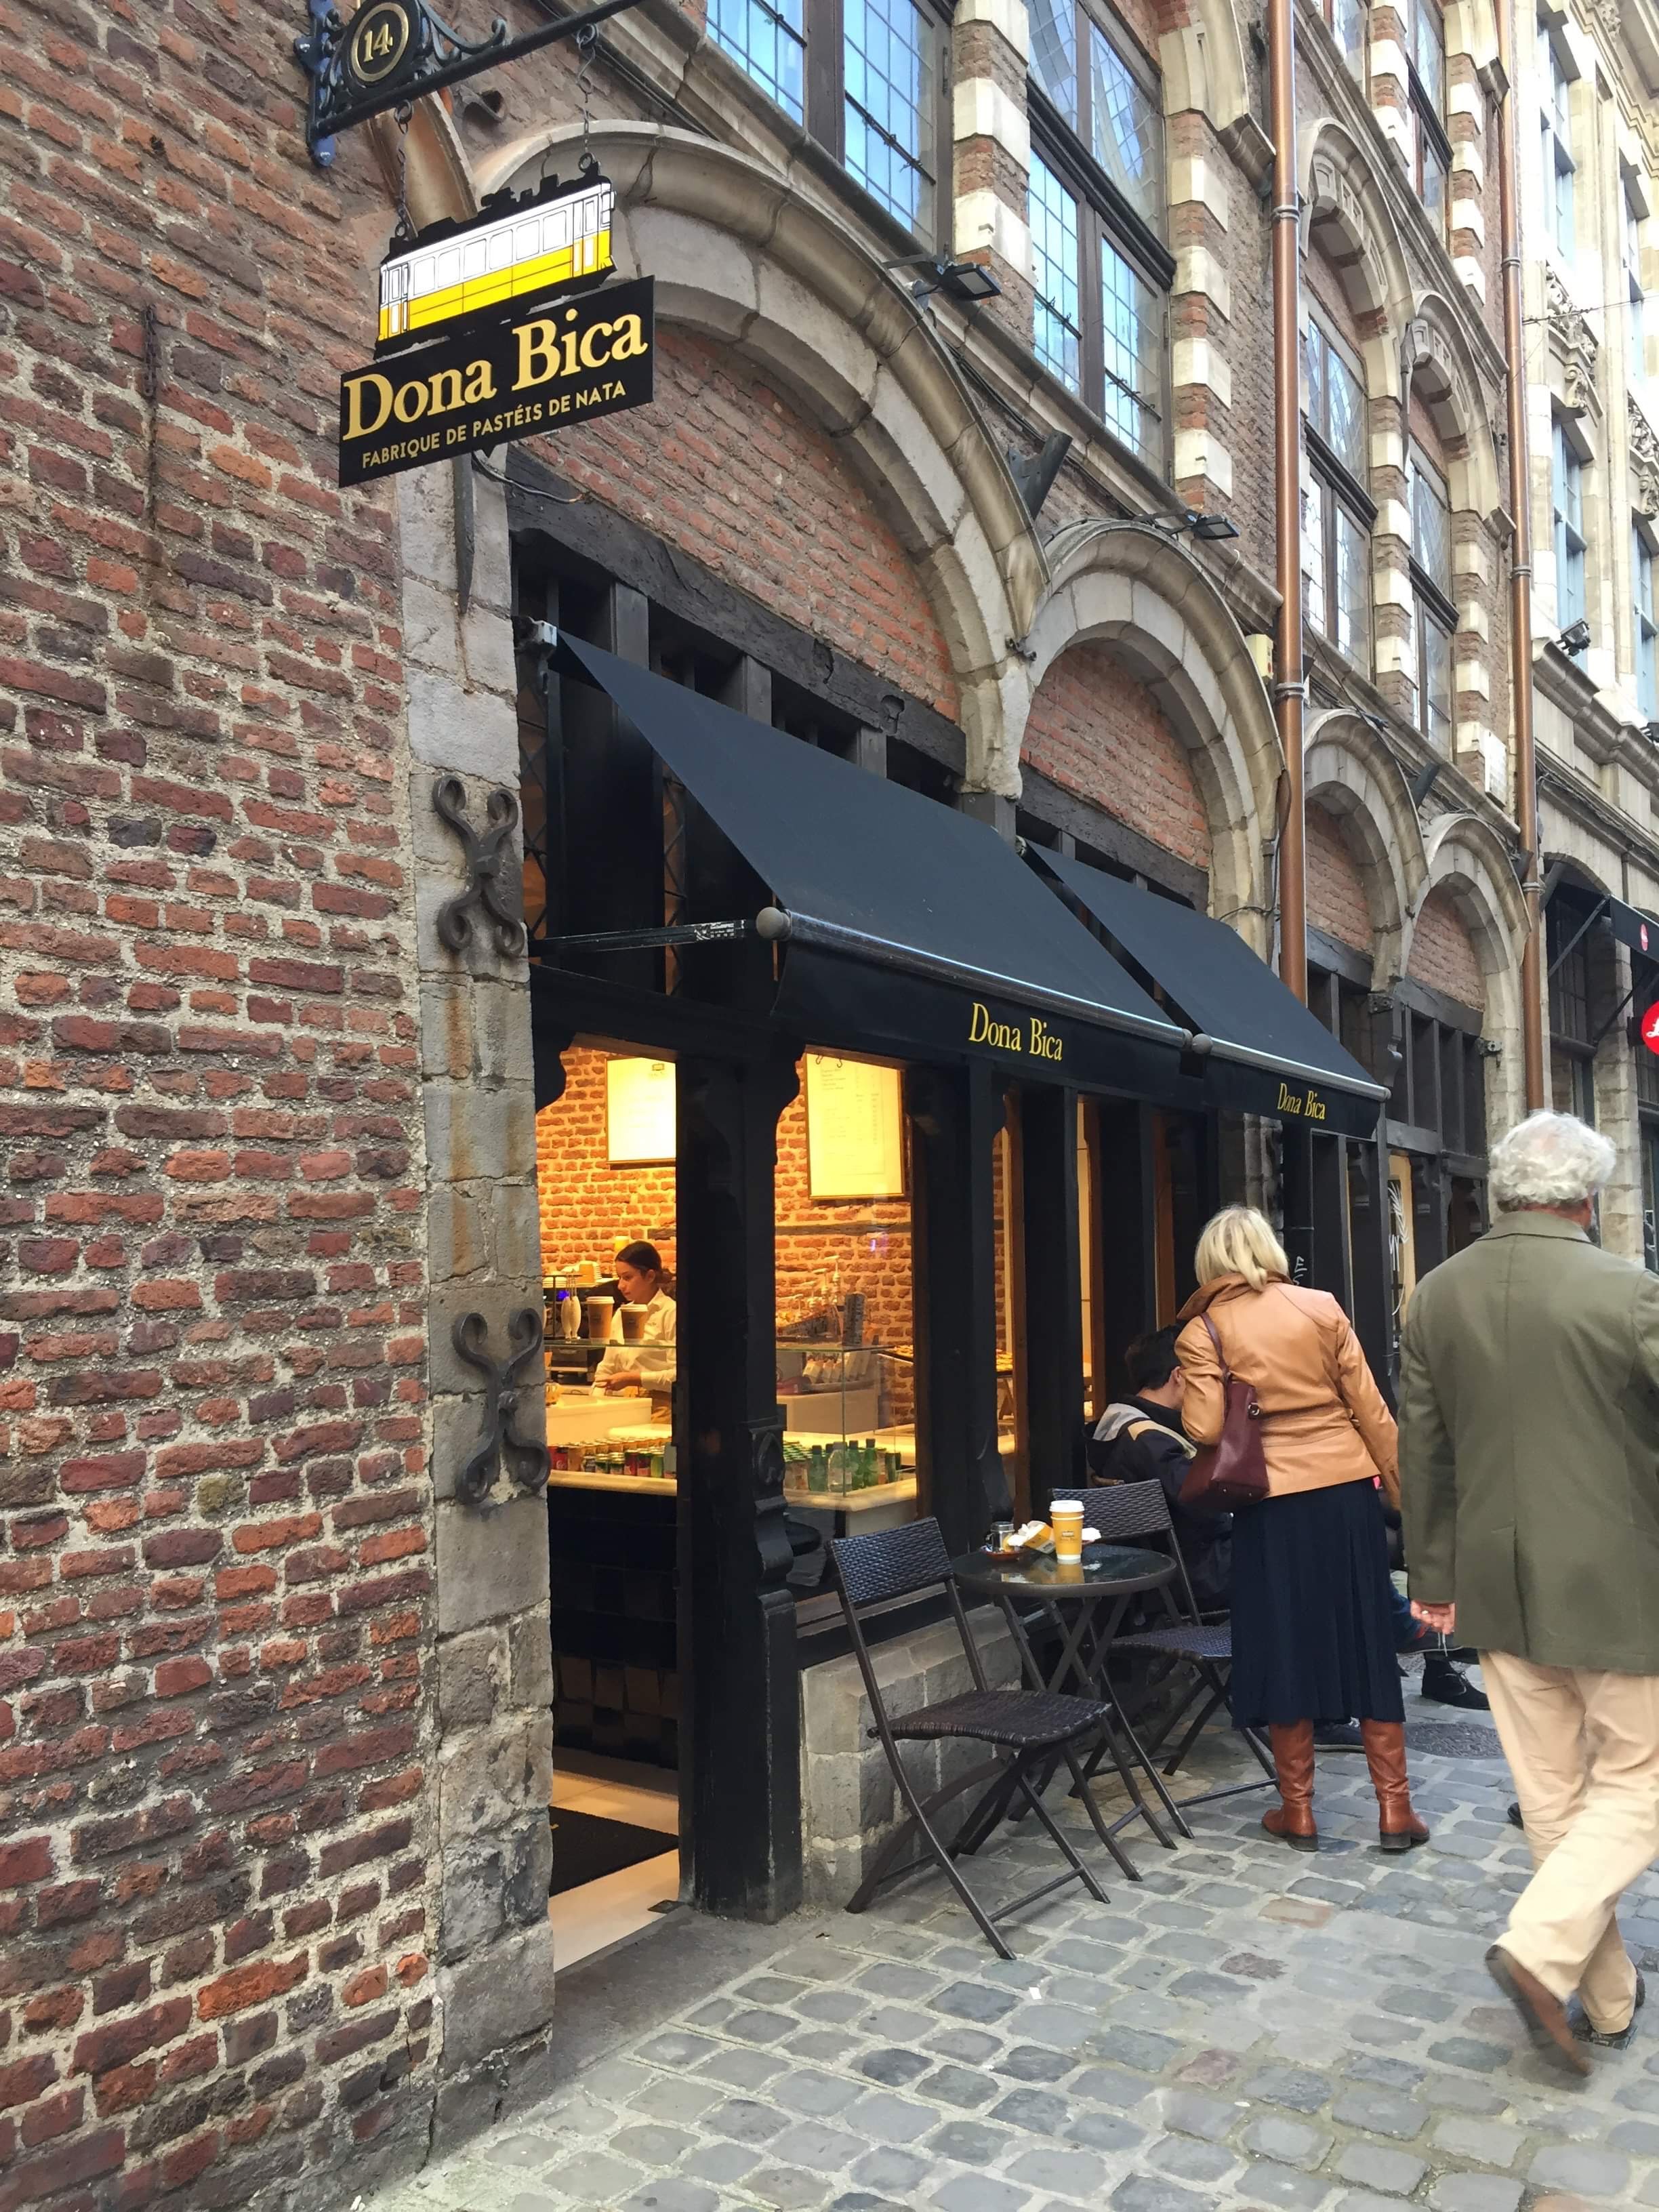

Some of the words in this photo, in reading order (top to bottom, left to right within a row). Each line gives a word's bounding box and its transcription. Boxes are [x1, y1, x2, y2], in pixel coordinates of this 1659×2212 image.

[363, 22, 393, 62] 14
[342, 359, 497, 441] Dona
[511, 308, 649, 391] Bica
[362, 432, 440, 468] FABRIQUE
[446, 424, 467, 445] DE
[473, 404, 543, 437] PASTÉIS
[549, 395, 571, 416] DE
[576, 380, 626, 409] NATA
[968, 1002, 1022, 1051] Dona
[1029, 1017, 1063, 1061] Bica
[1277, 1082, 1302, 1114] Dona
[1304, 1090, 1326, 1120] Bica
